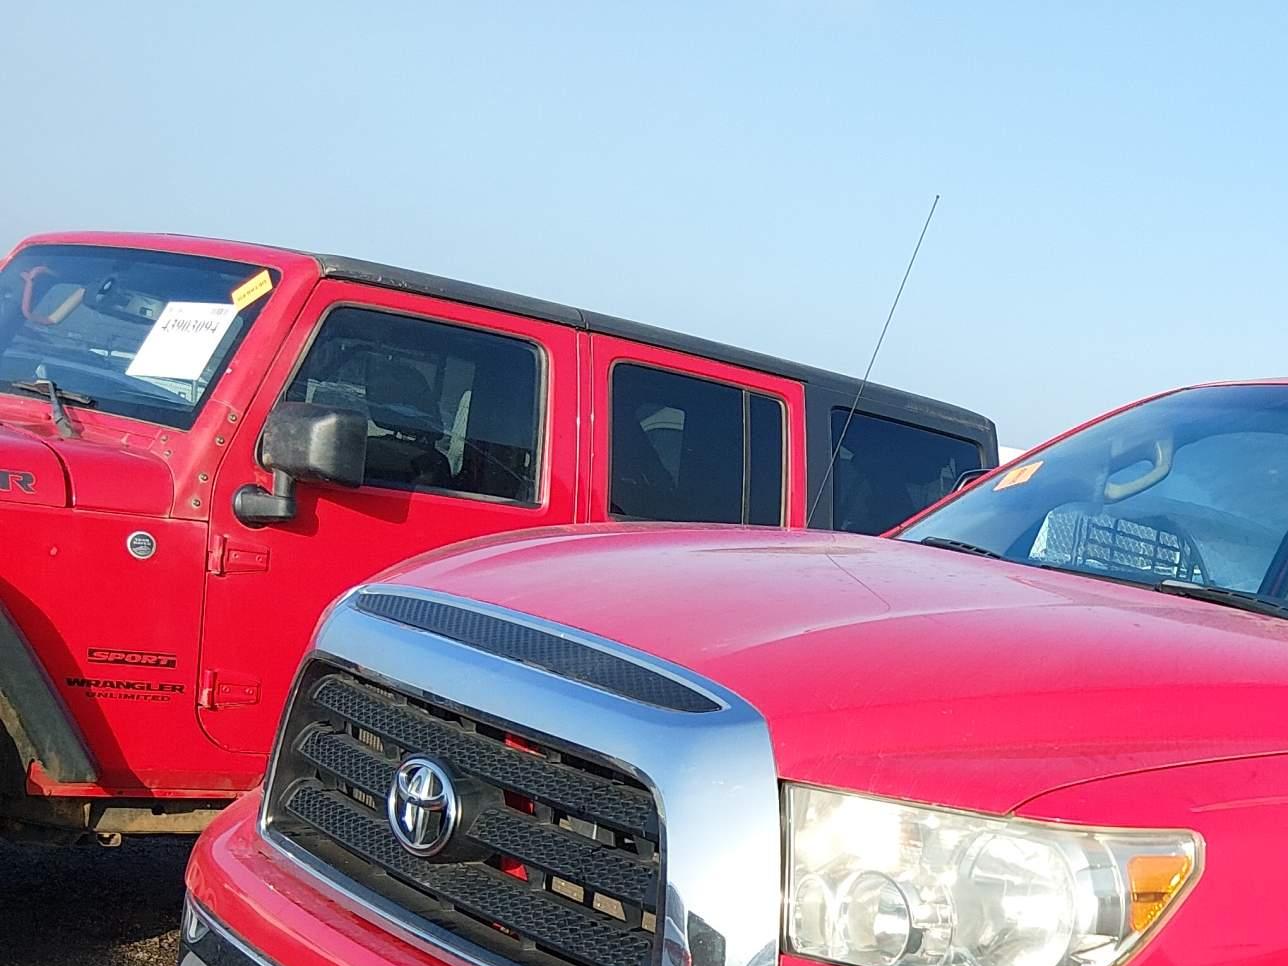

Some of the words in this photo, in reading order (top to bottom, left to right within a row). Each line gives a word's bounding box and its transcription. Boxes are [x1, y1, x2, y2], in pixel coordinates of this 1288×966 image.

[93, 651, 176, 665] SPORT
[66, 677, 185, 694] WRANGLER
[85, 690, 171, 702] UNLIMITED
